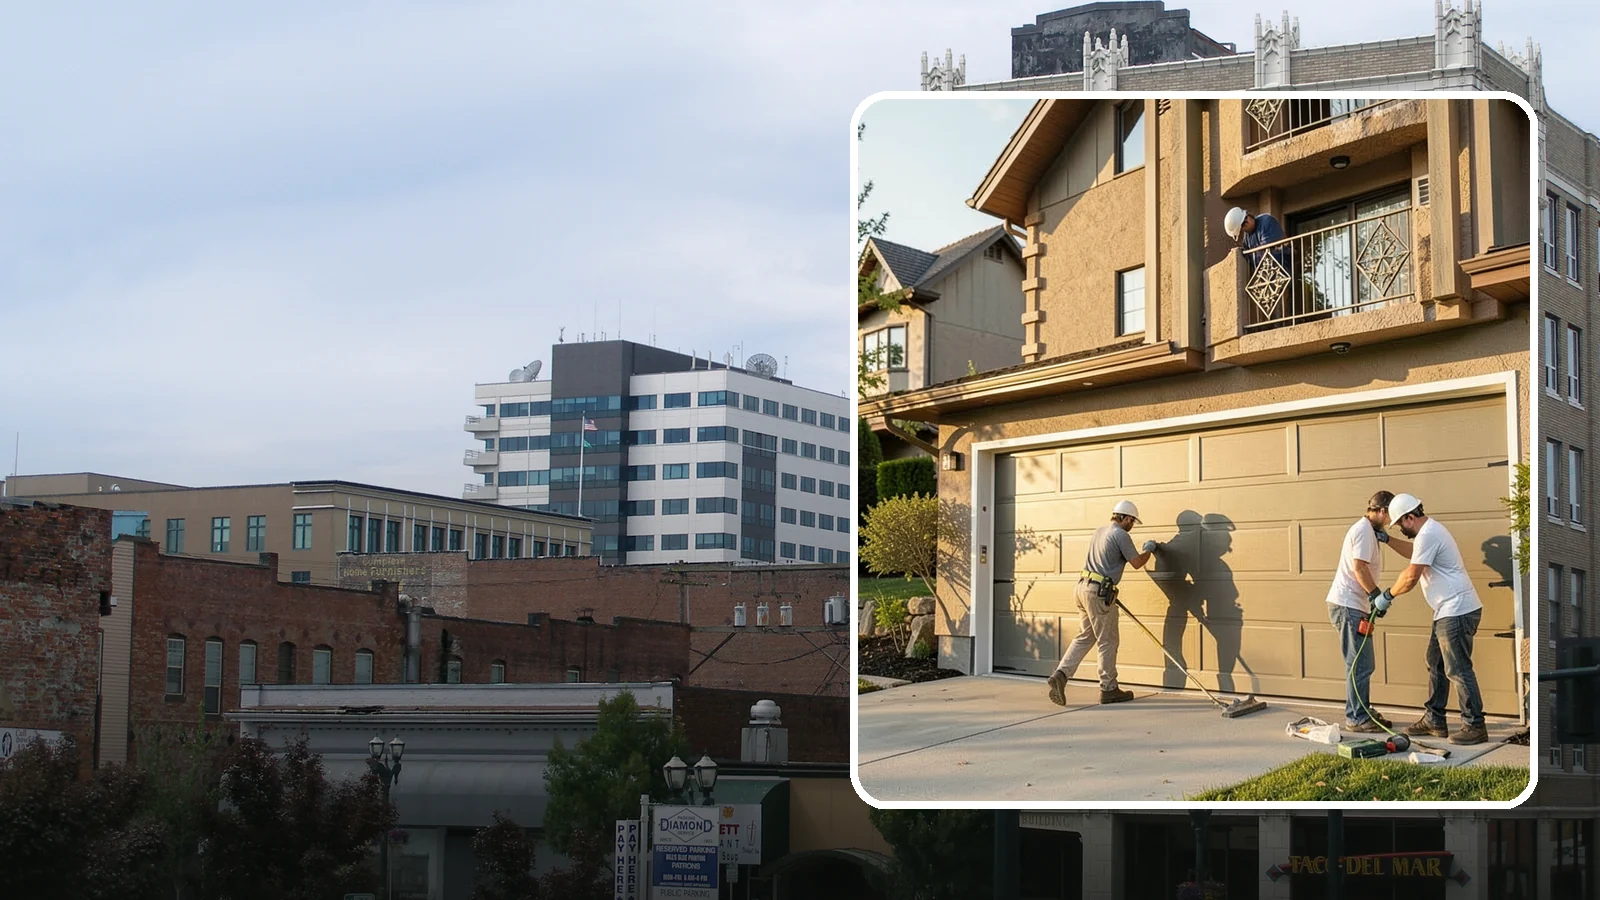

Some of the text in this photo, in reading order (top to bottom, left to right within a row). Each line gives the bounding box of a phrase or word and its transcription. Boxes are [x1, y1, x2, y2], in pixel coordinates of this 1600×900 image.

[370, 566, 427, 576] Furnishers
[660, 818, 713, 832] DIAMOND
[1022, 816, 1069, 828] BUILDING
[719, 824, 740, 835] ETT
[617, 825, 625, 852] PAY
[628, 824, 636, 852] PAY
[719, 839, 740, 849] ANT
[721, 852, 739, 861] Soup
[1345, 856, 1385, 875] DEL
[1392, 857, 1443, 877] MAR
[616, 856, 624, 893] HERE
[628, 856, 636, 893] HERE
[660, 888, 682, 896] PUBLIC
